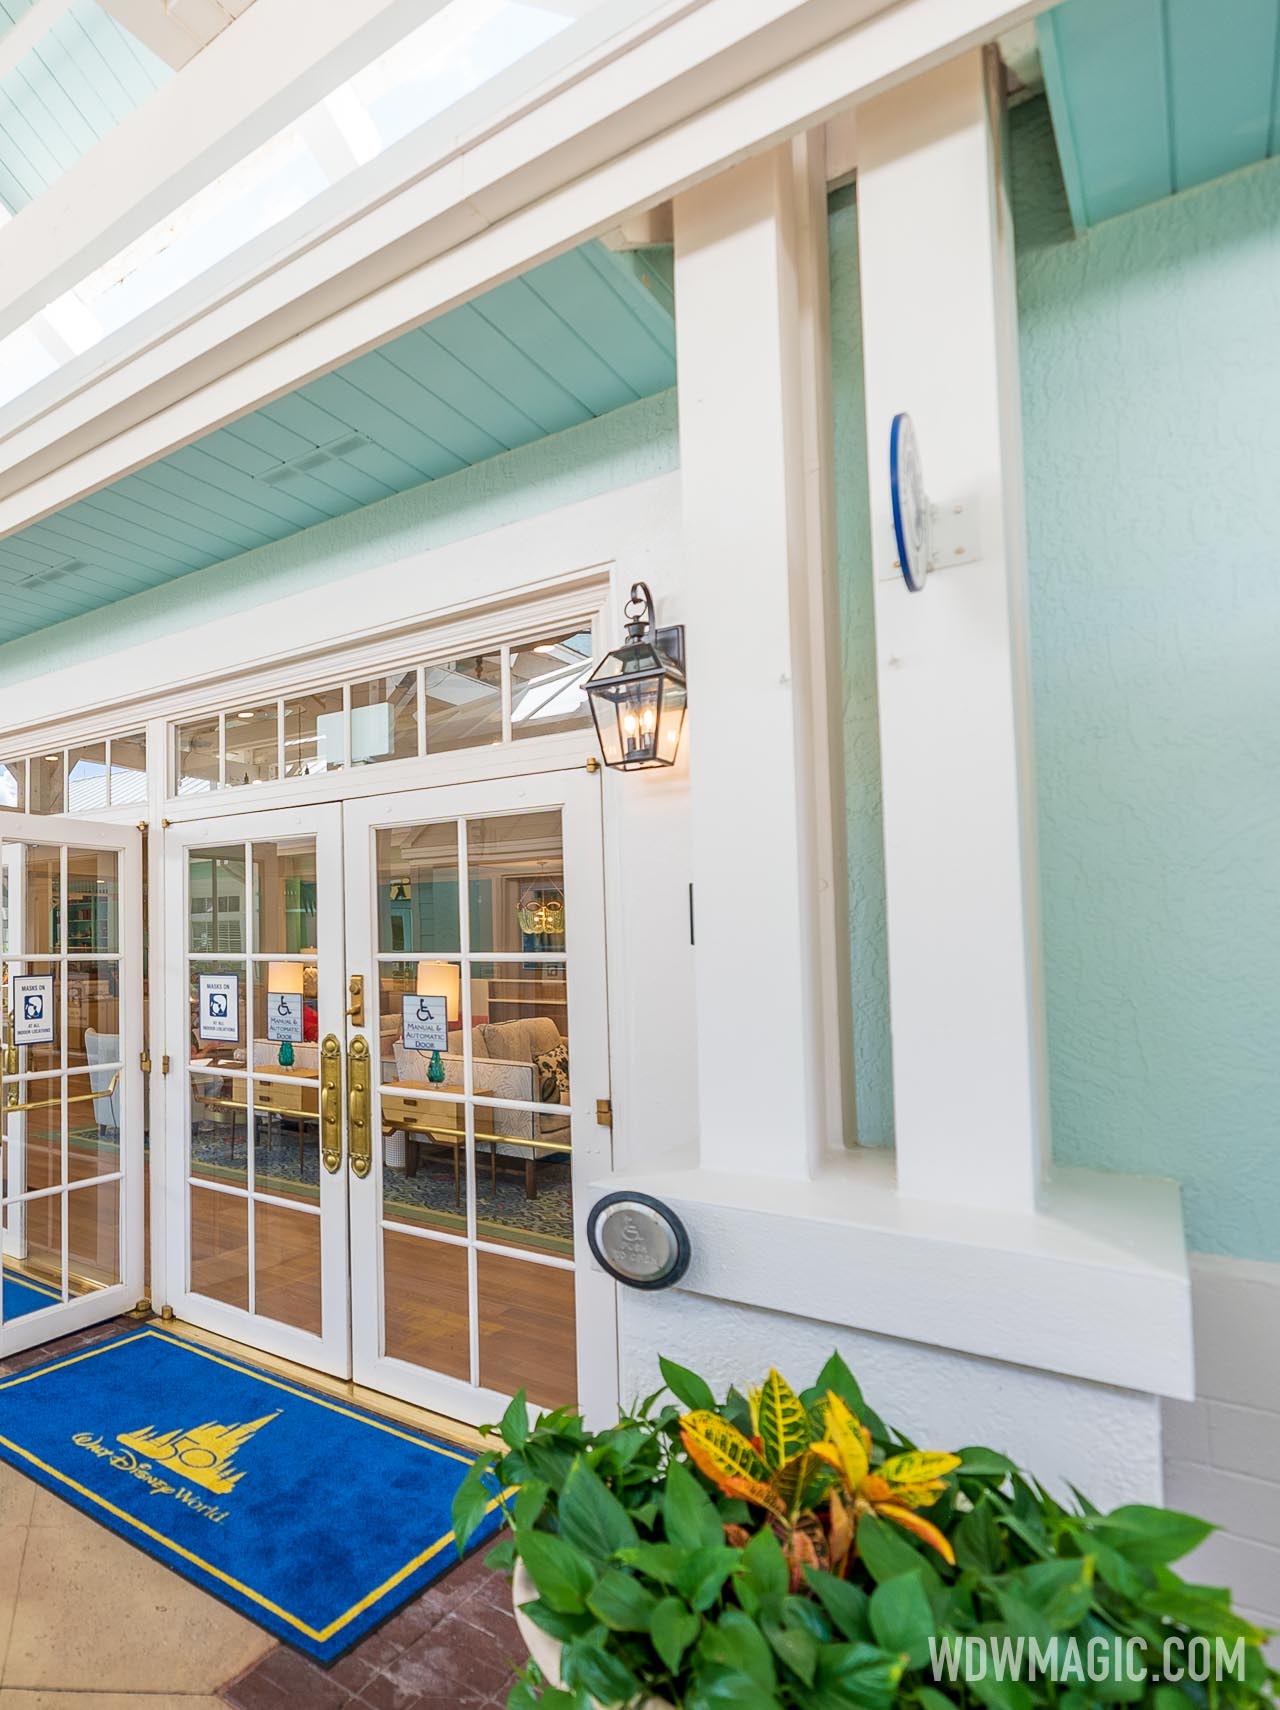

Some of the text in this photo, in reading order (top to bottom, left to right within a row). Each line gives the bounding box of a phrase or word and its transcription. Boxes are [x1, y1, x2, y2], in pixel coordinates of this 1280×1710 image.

[71, 1432, 230, 1524] Walt Disney World
